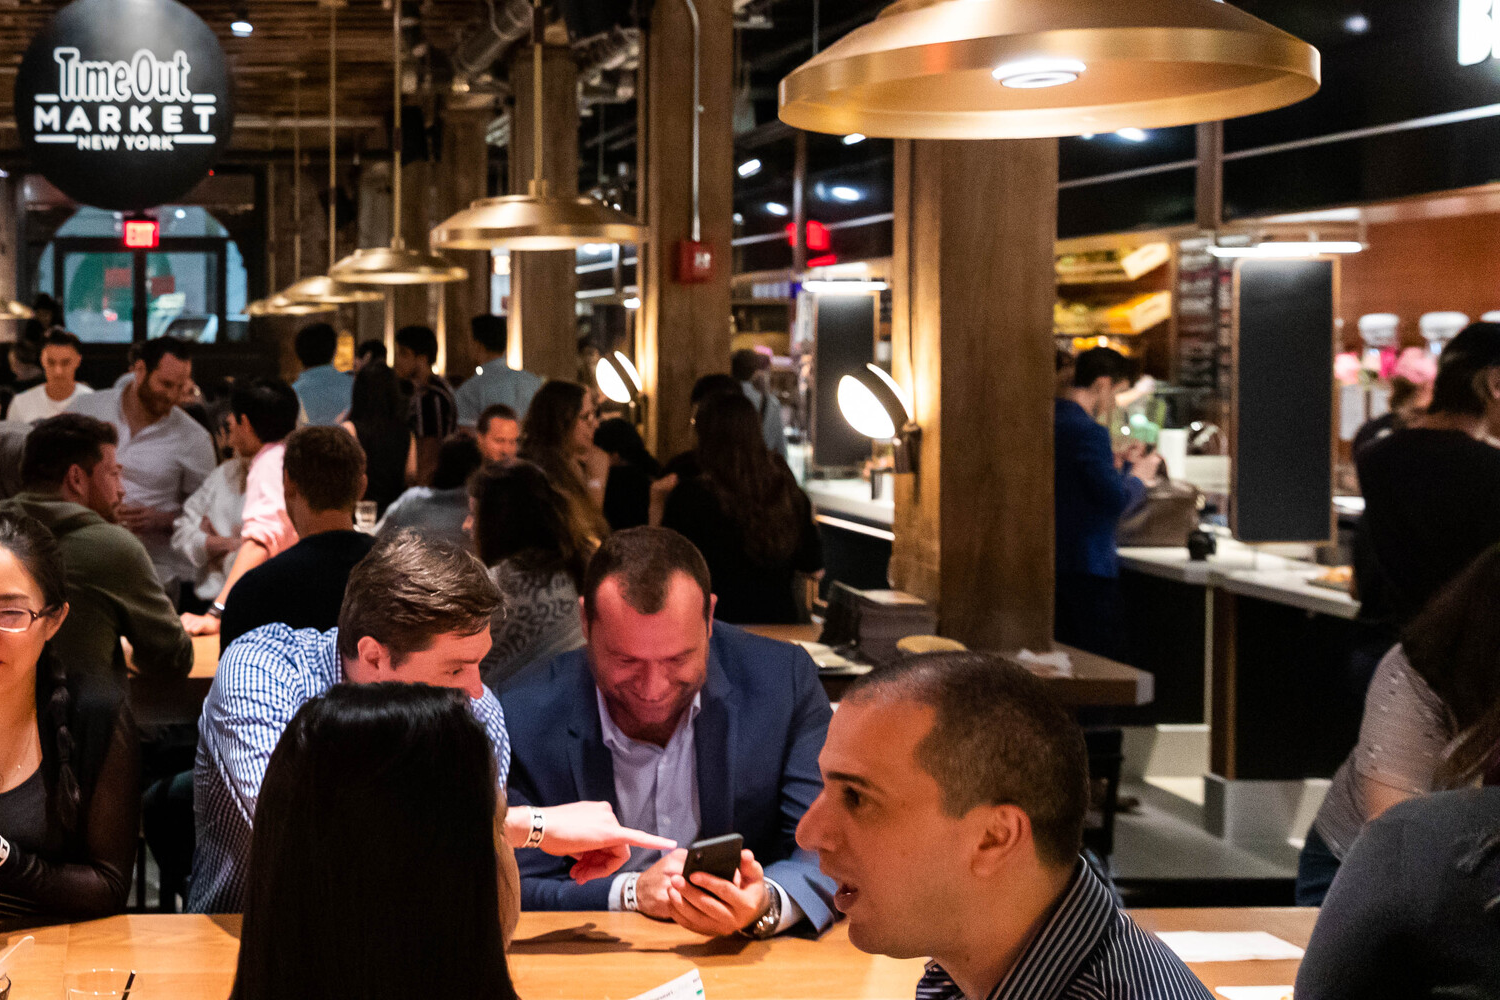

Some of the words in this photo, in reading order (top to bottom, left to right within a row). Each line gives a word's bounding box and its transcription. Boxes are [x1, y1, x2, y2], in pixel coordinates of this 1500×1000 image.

[34, 105, 217, 133] MARKET
[77, 135, 118, 151] NEW
[122, 135, 174, 151] YORK
